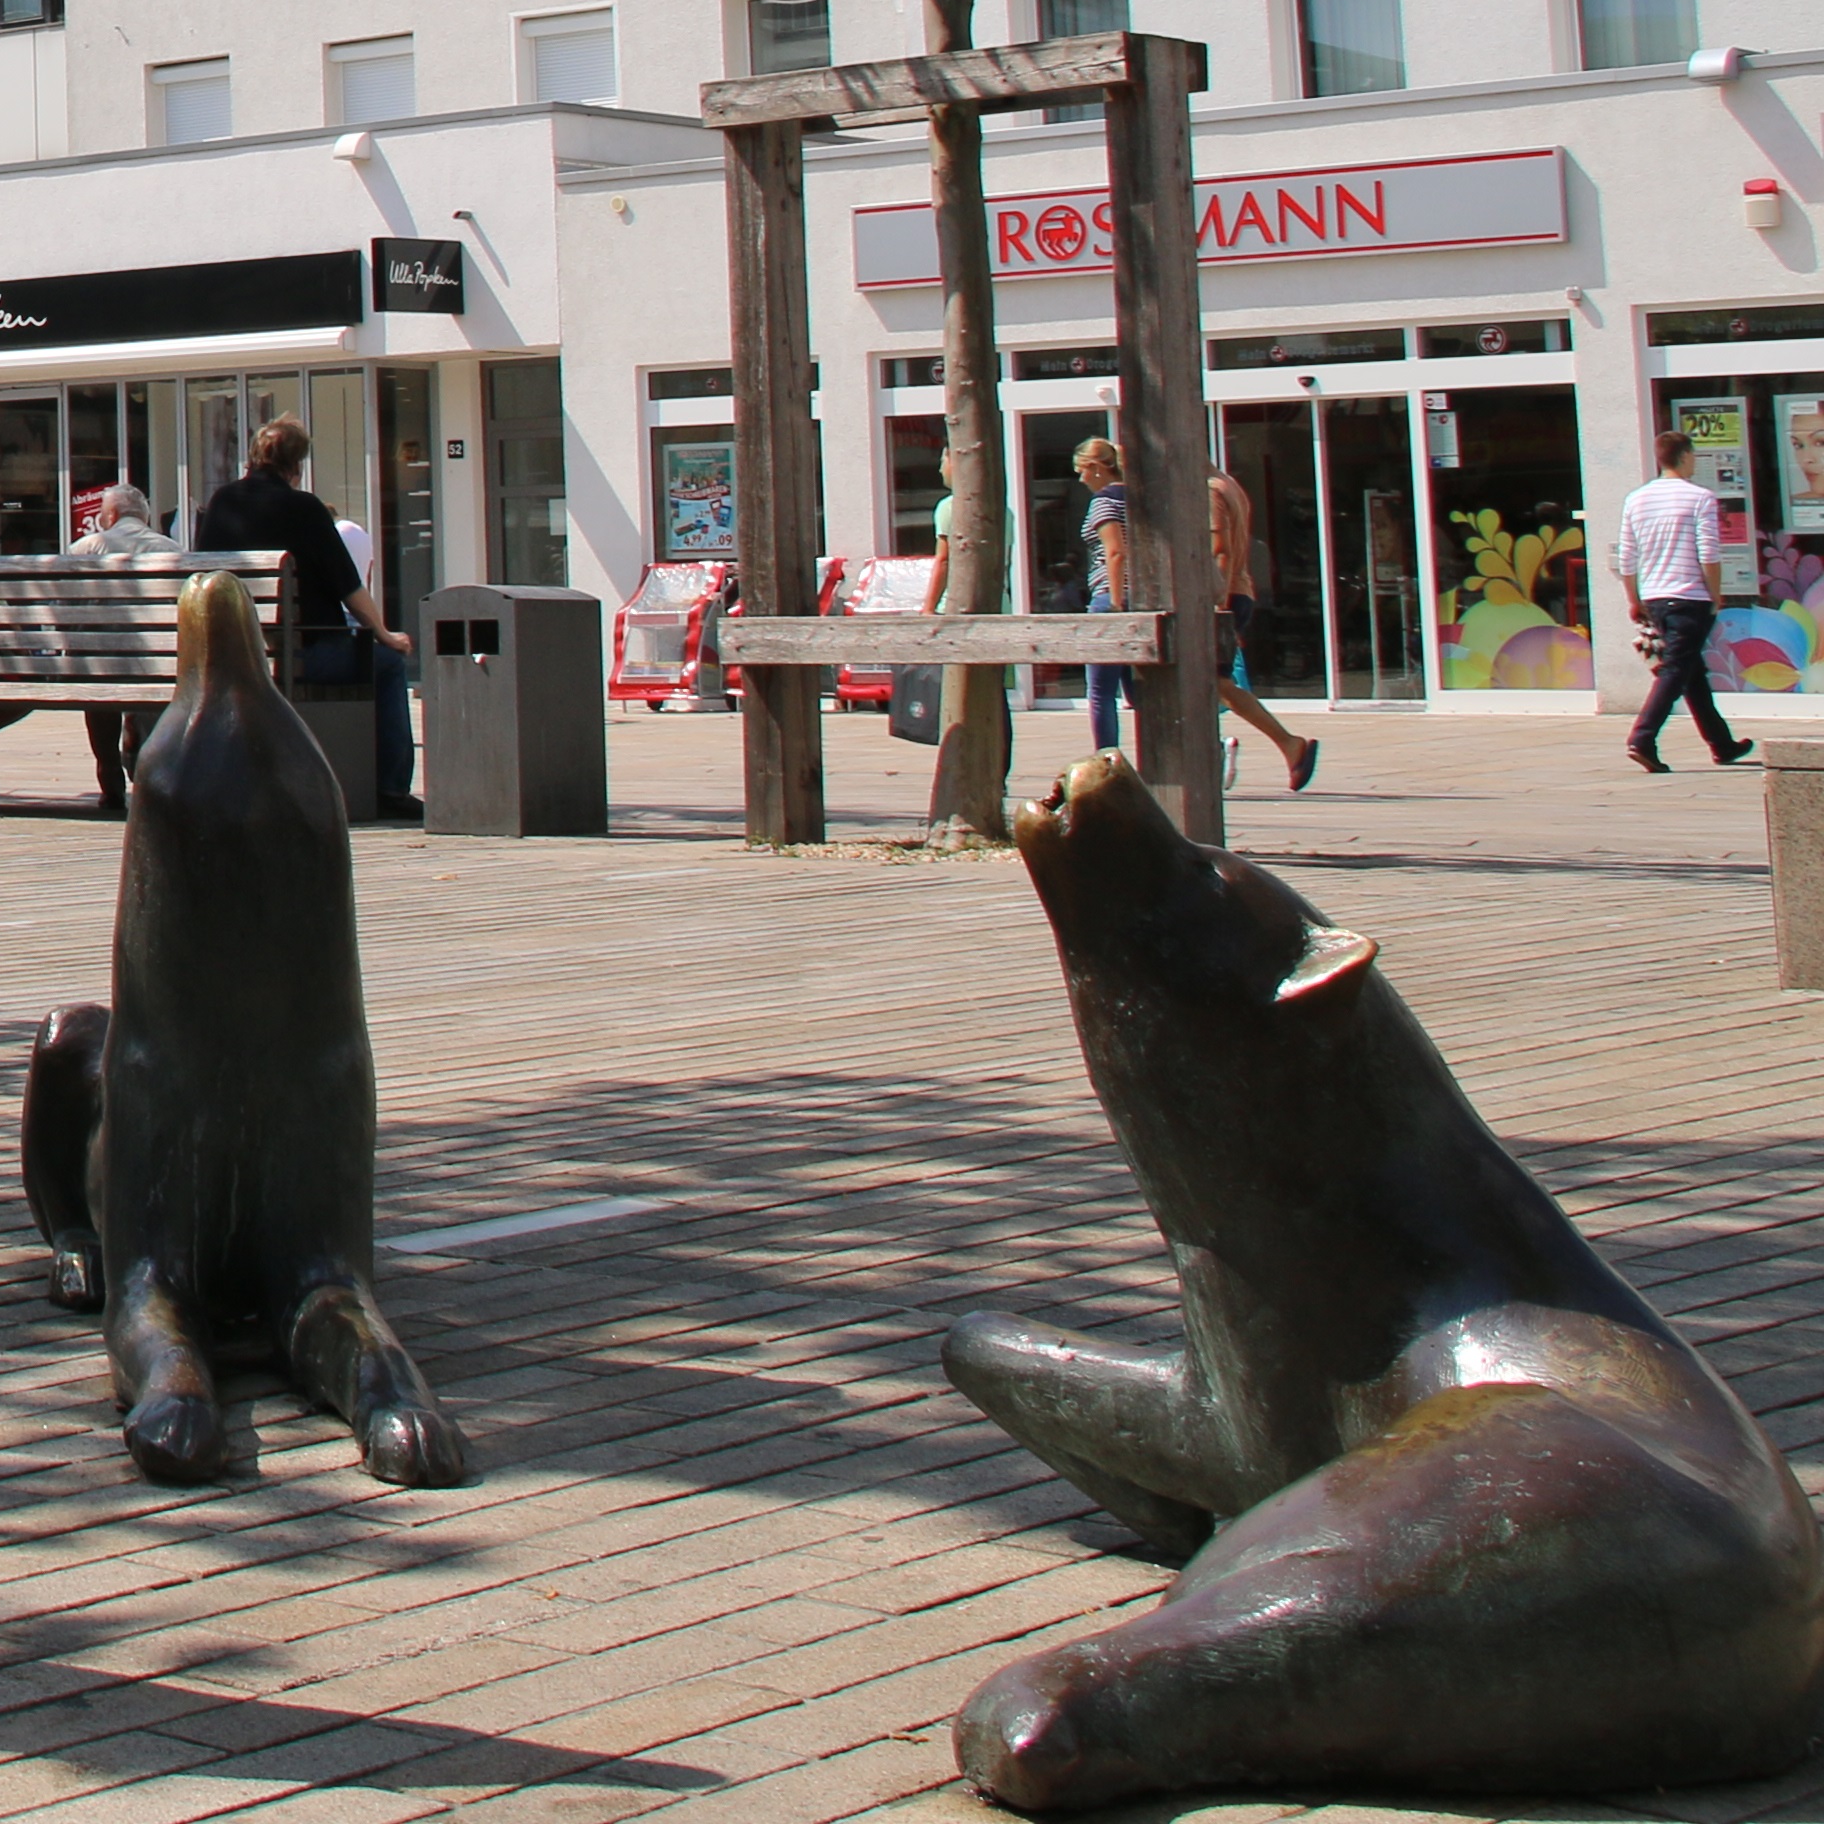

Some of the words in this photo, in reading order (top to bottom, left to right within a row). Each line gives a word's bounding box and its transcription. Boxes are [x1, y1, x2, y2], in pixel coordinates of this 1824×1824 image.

[998, 180, 1386, 264] ROSMANN
[389, 260, 414, 284] Ulla
[414, 261, 459, 292] Popken
[448, 444, 462, 455] 52
